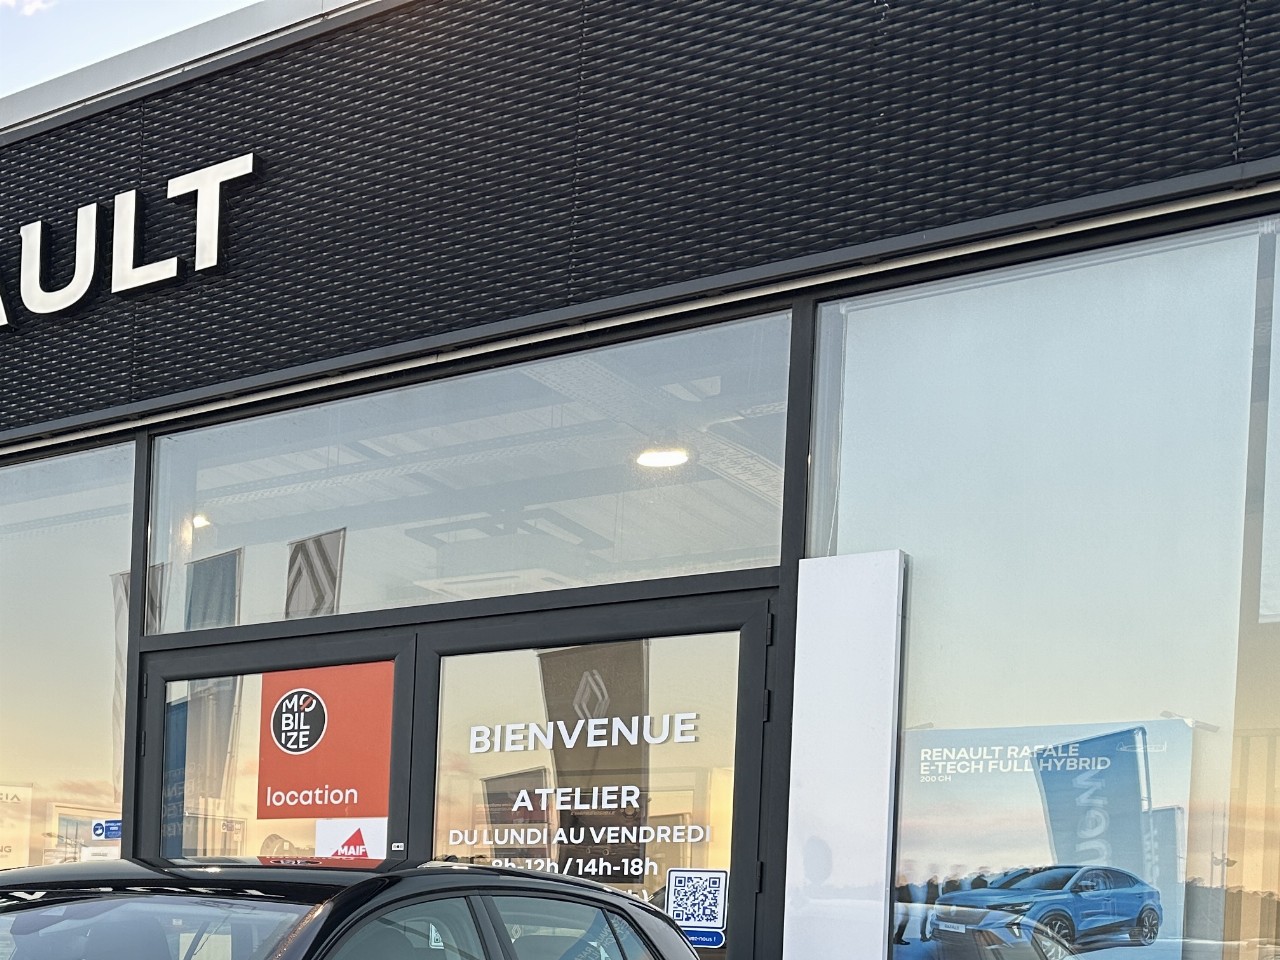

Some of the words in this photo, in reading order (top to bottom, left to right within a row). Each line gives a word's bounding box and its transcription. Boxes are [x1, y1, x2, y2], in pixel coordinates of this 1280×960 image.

[470, 712, 699, 754] BIENVENUE
[920, 746, 1004, 761] RENAULT
[1007, 743, 1080, 759] RAFALE
[920, 760, 984, 775] E-TECH
[988, 760, 1035, 773] FULL
[1039, 757, 1111, 772] HYBRID
[920, 775, 937, 783] 200
[938, 774, 952, 783] CH
[266, 785, 358, 807] location
[512, 785, 641, 812] ATELIER
[449, 829, 478, 846] DU
[483, 828, 548, 846] LUNDI
[552, 827, 585, 845] AU
[589, 825, 711, 844] VENDREDI
[338, 844, 367, 856] MAIF
[576, 857, 658, 876] 14h-18h
